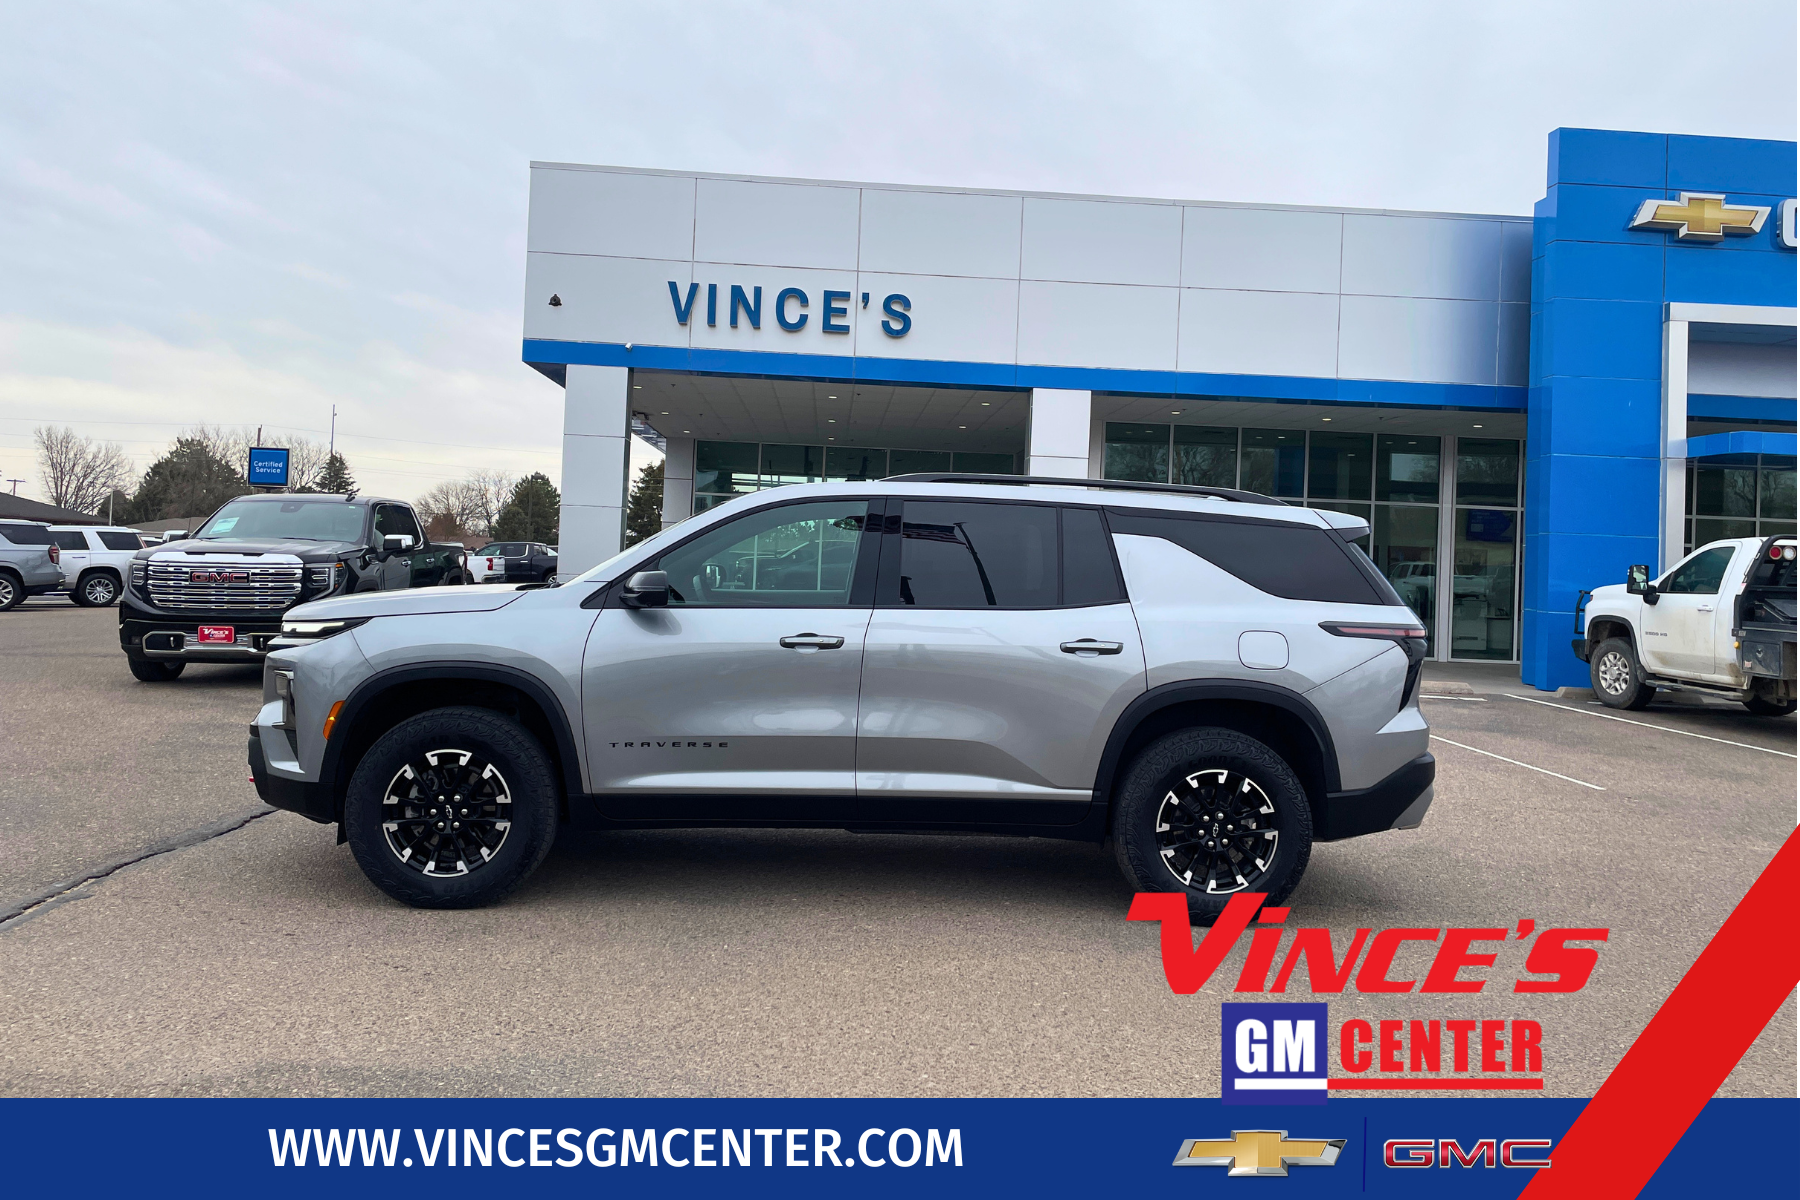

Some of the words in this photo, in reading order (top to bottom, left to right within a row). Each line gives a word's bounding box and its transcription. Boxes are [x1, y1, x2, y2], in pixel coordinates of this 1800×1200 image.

[668, 280, 912, 338] VINCE'S
[253, 460, 283, 468] Certified
[192, 573, 247, 582] GMC
